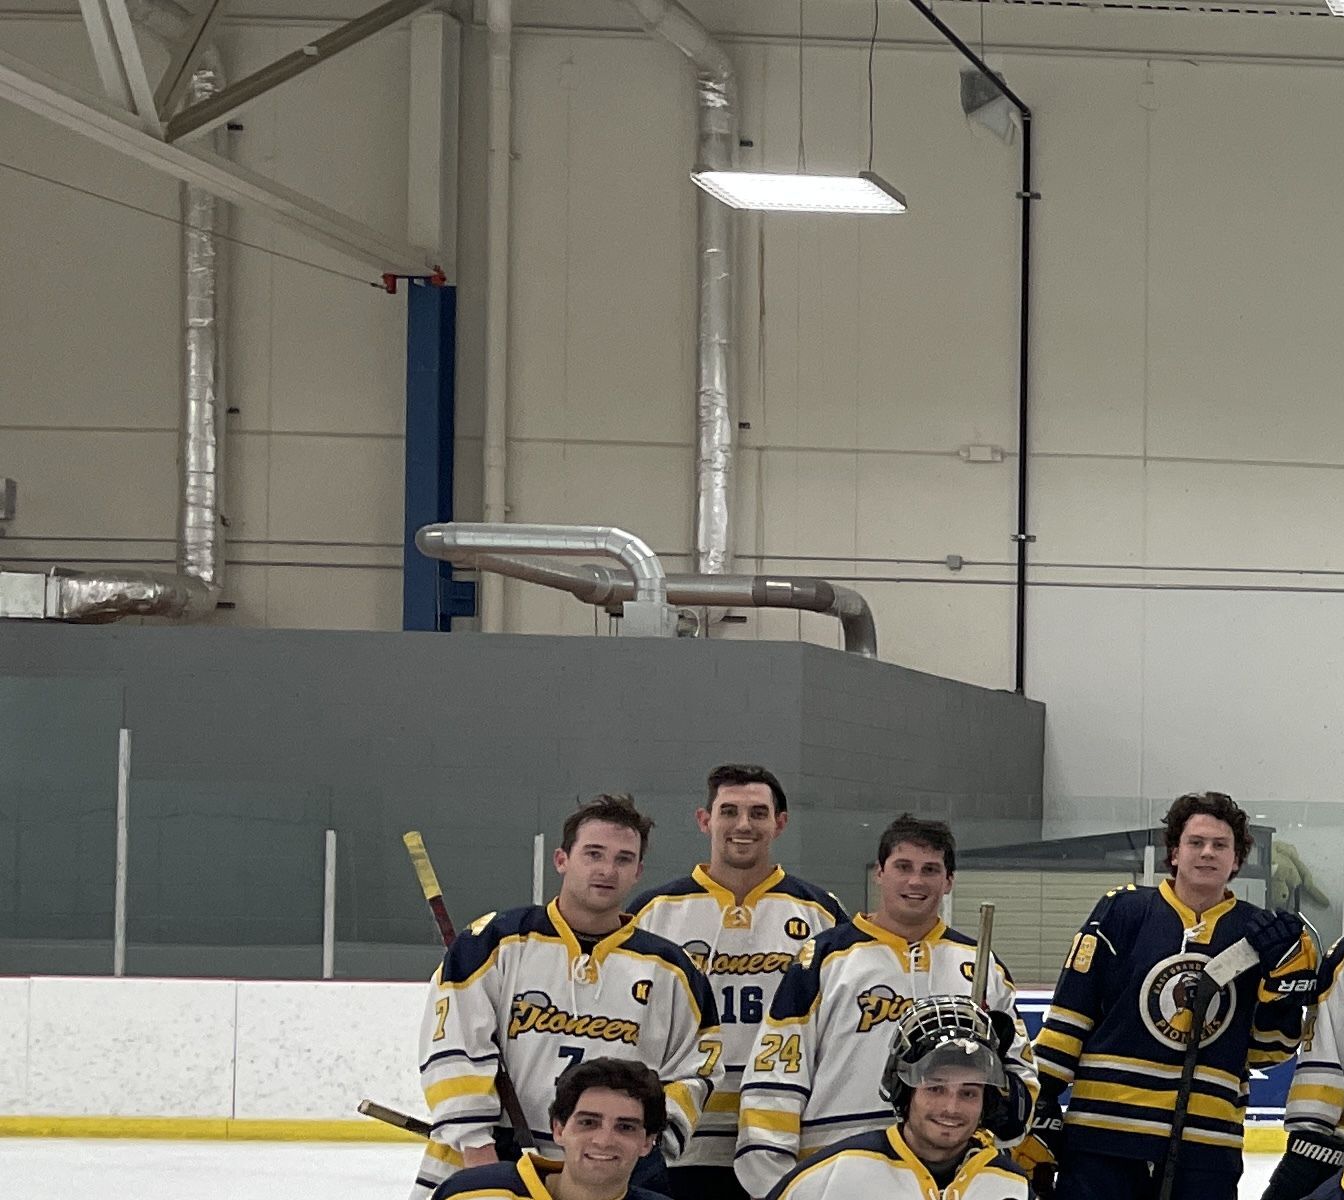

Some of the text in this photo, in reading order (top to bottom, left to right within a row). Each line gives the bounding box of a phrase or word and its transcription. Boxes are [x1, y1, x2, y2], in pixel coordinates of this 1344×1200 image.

[431, 995, 450, 1042] 7
[721, 985, 764, 1026] 16
[556, 1045, 587, 1086] 7
[696, 1040, 722, 1077] 7
[752, 1033, 802, 1074] 24
